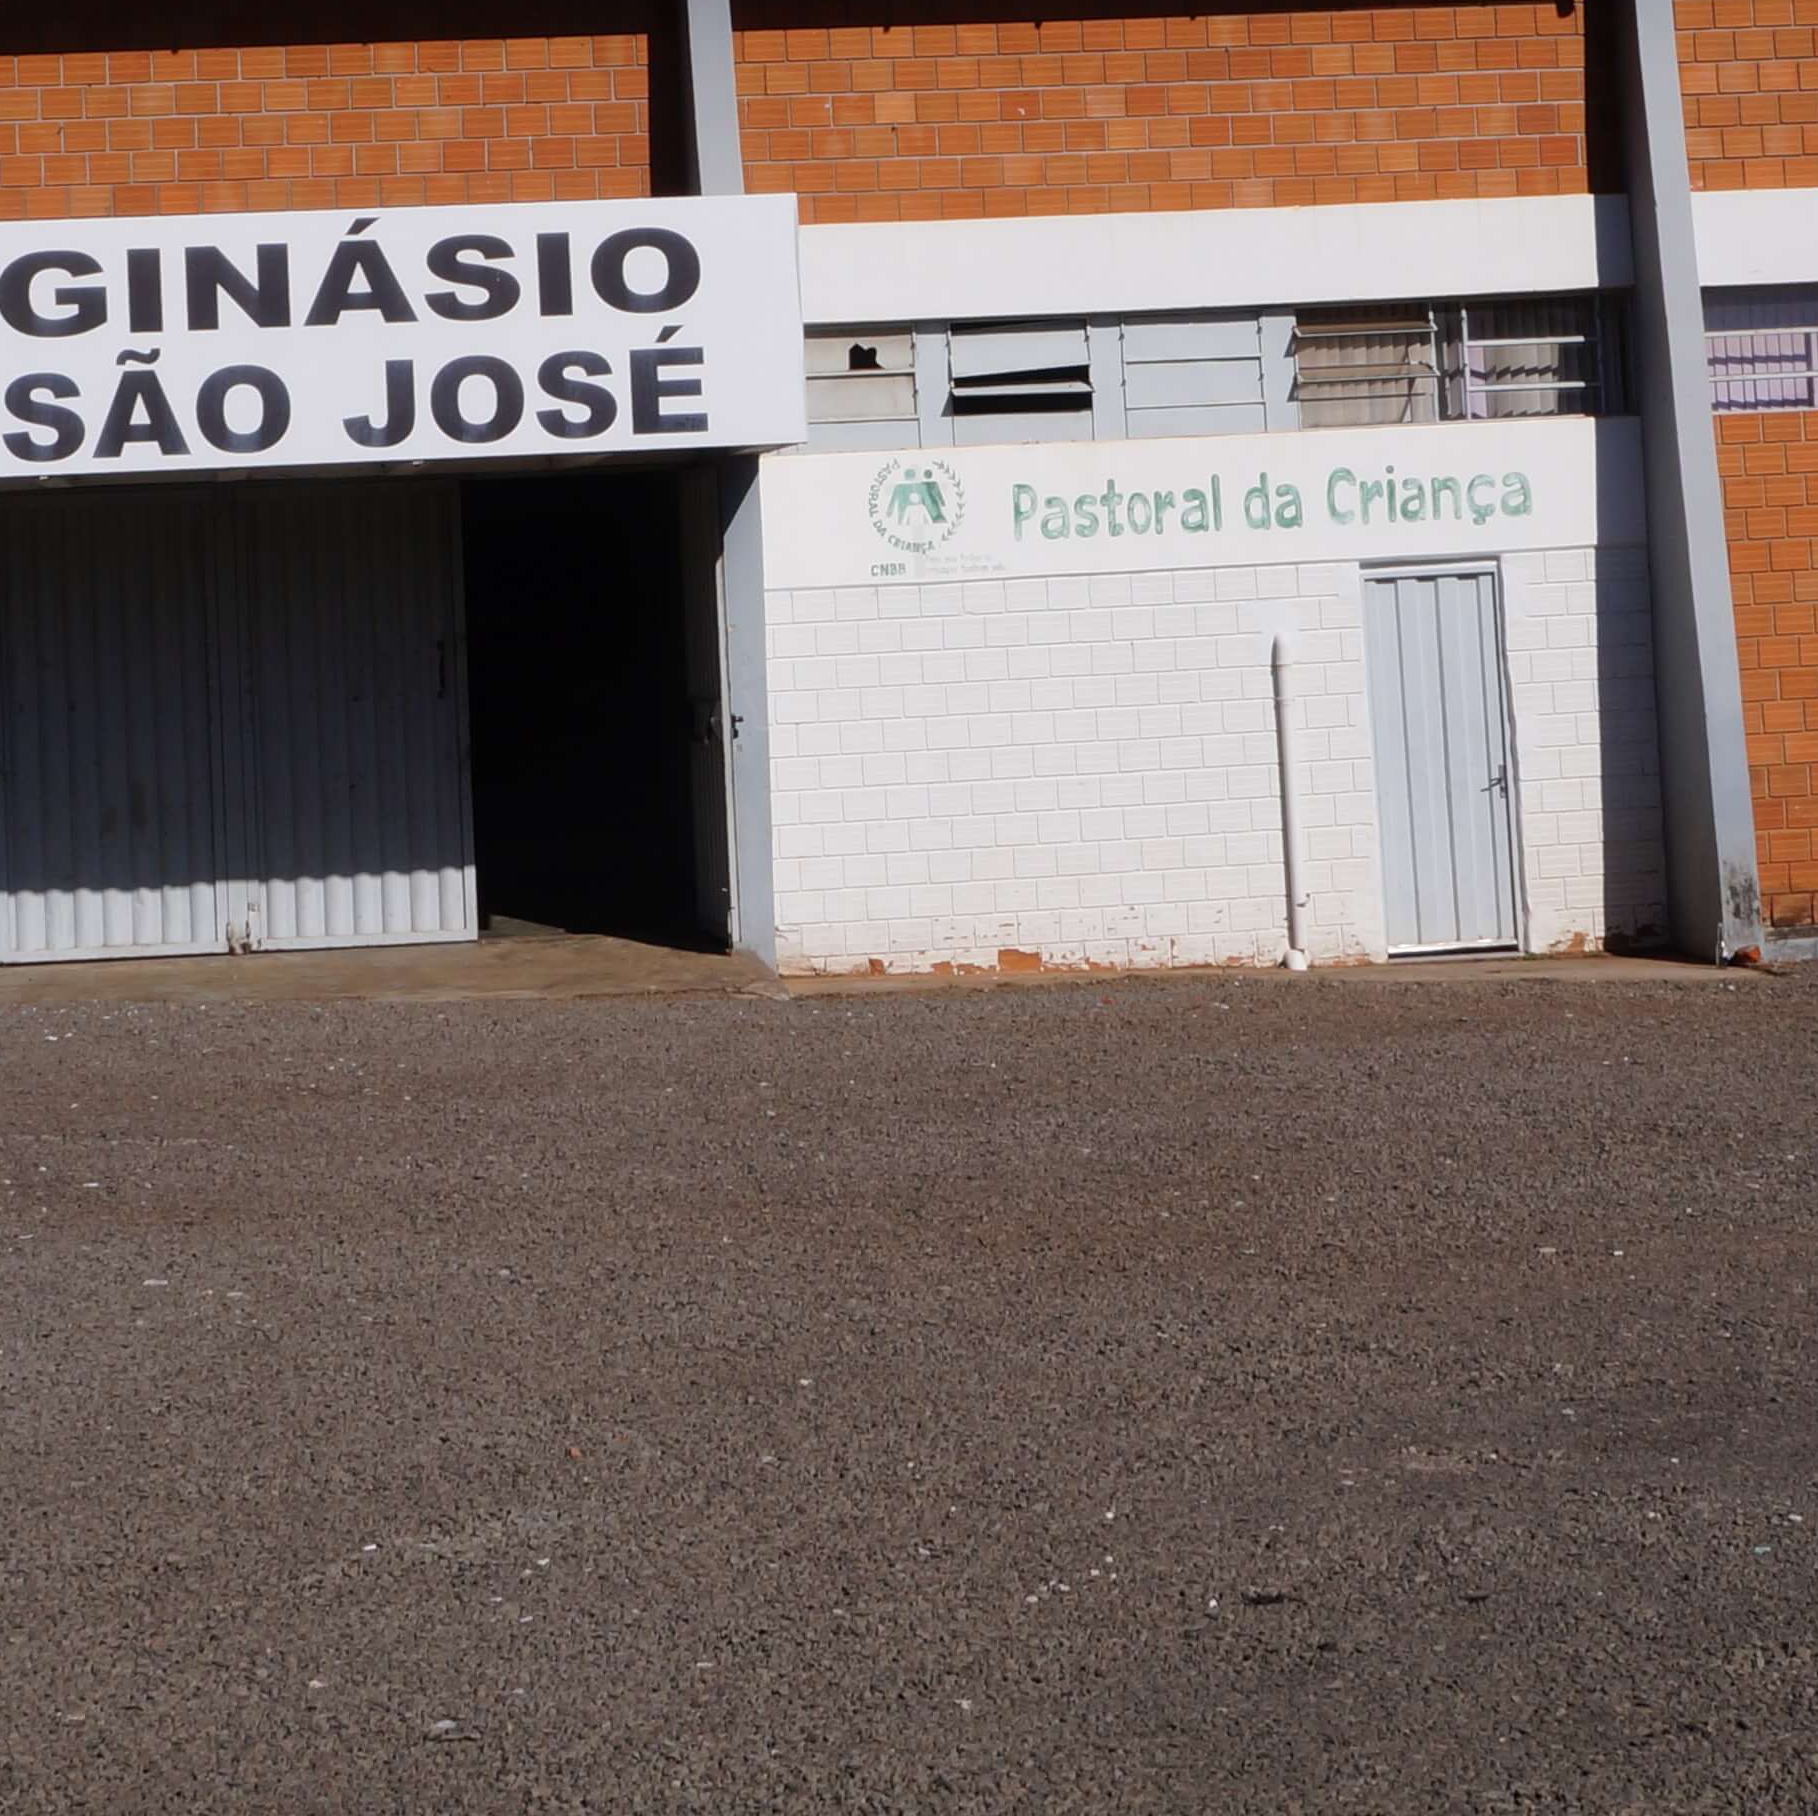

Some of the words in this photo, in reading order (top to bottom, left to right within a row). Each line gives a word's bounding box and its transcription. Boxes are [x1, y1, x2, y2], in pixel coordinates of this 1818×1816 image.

[2, 349, 291, 461] SÃO
[343, 325, 709, 447] JOSÉ
[868, 458, 901, 518] PASTORAL
[1012, 473, 1224, 541] Pastoral
[1244, 471, 1304, 530] da
[1325, 465, 1534, 525] Criança
[873, 520, 888, 537] DA
[870, 562, 907, 577] CNBB
